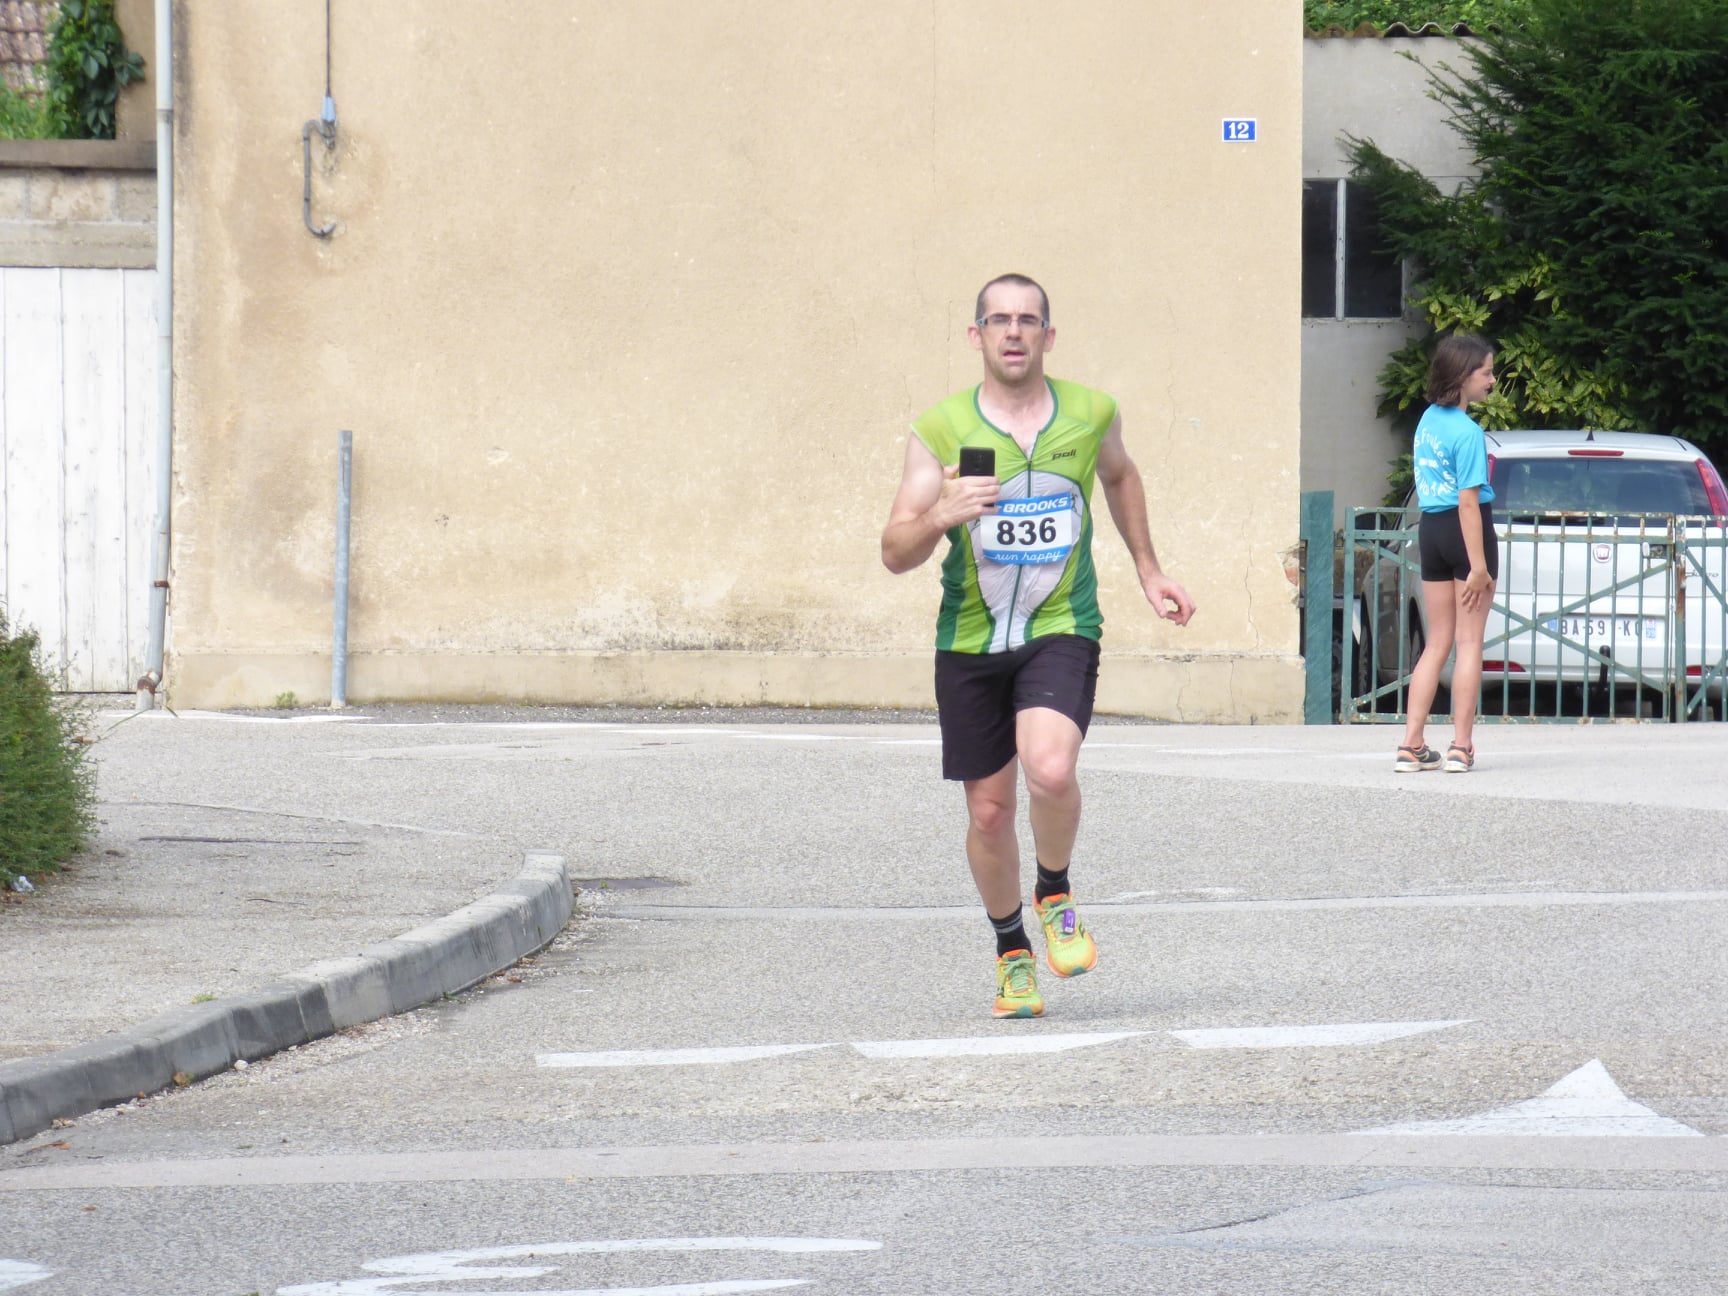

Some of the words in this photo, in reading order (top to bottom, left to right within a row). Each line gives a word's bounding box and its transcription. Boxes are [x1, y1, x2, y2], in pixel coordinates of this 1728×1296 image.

[1228, 121, 1250, 139] 12
[1003, 496, 1069, 514] BROOKS
[996, 516, 1057, 546] 836
[1021, 550, 1063, 564] happy
